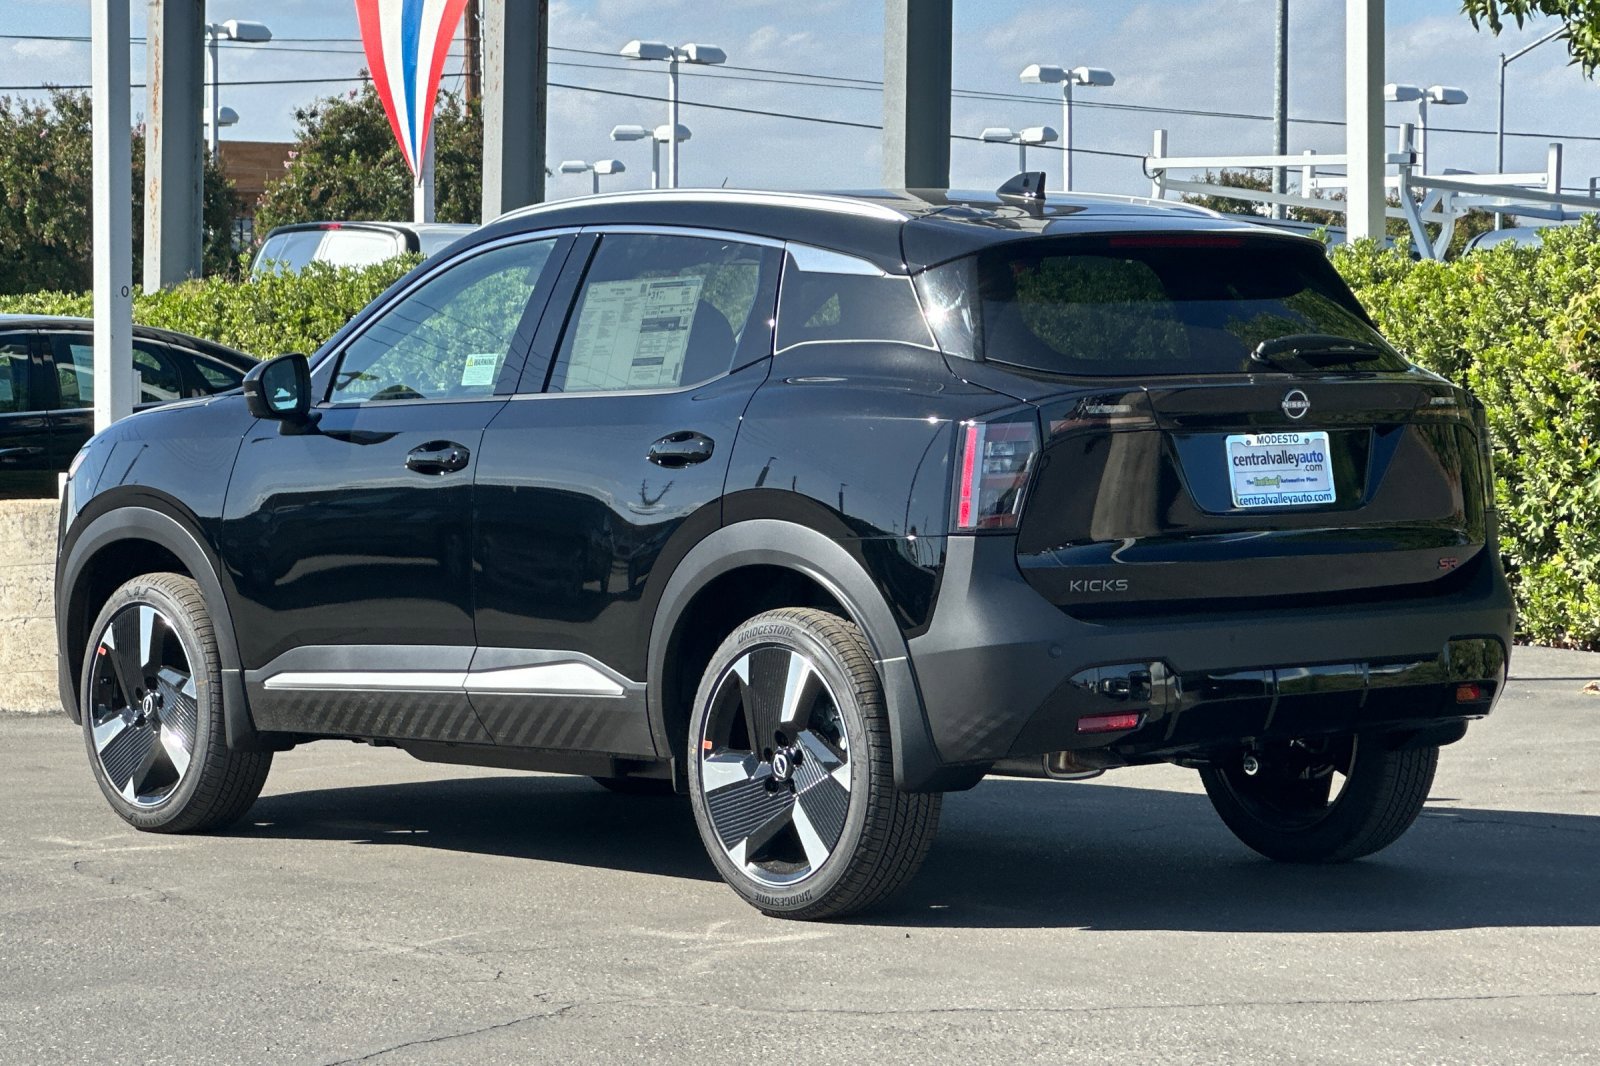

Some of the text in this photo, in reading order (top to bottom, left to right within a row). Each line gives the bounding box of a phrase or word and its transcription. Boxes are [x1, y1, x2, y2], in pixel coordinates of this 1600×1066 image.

[474, 358, 495, 366] WARNING
[1281, 400, 1311, 409] NISSAN
[1256, 434, 1299, 444] MODESTO
[1233, 450, 1324, 467] centralvalleyauto
[1302, 463, 1323, 472] .com
[1239, 493, 1333, 506] centralvalleyauto.com
[1439, 557, 1458, 570] SR
[1069, 579, 1128, 592] KICKS
[737, 624, 796, 644] BRIDGESTONE
[754, 889, 813, 906] BRIDGESTONE
